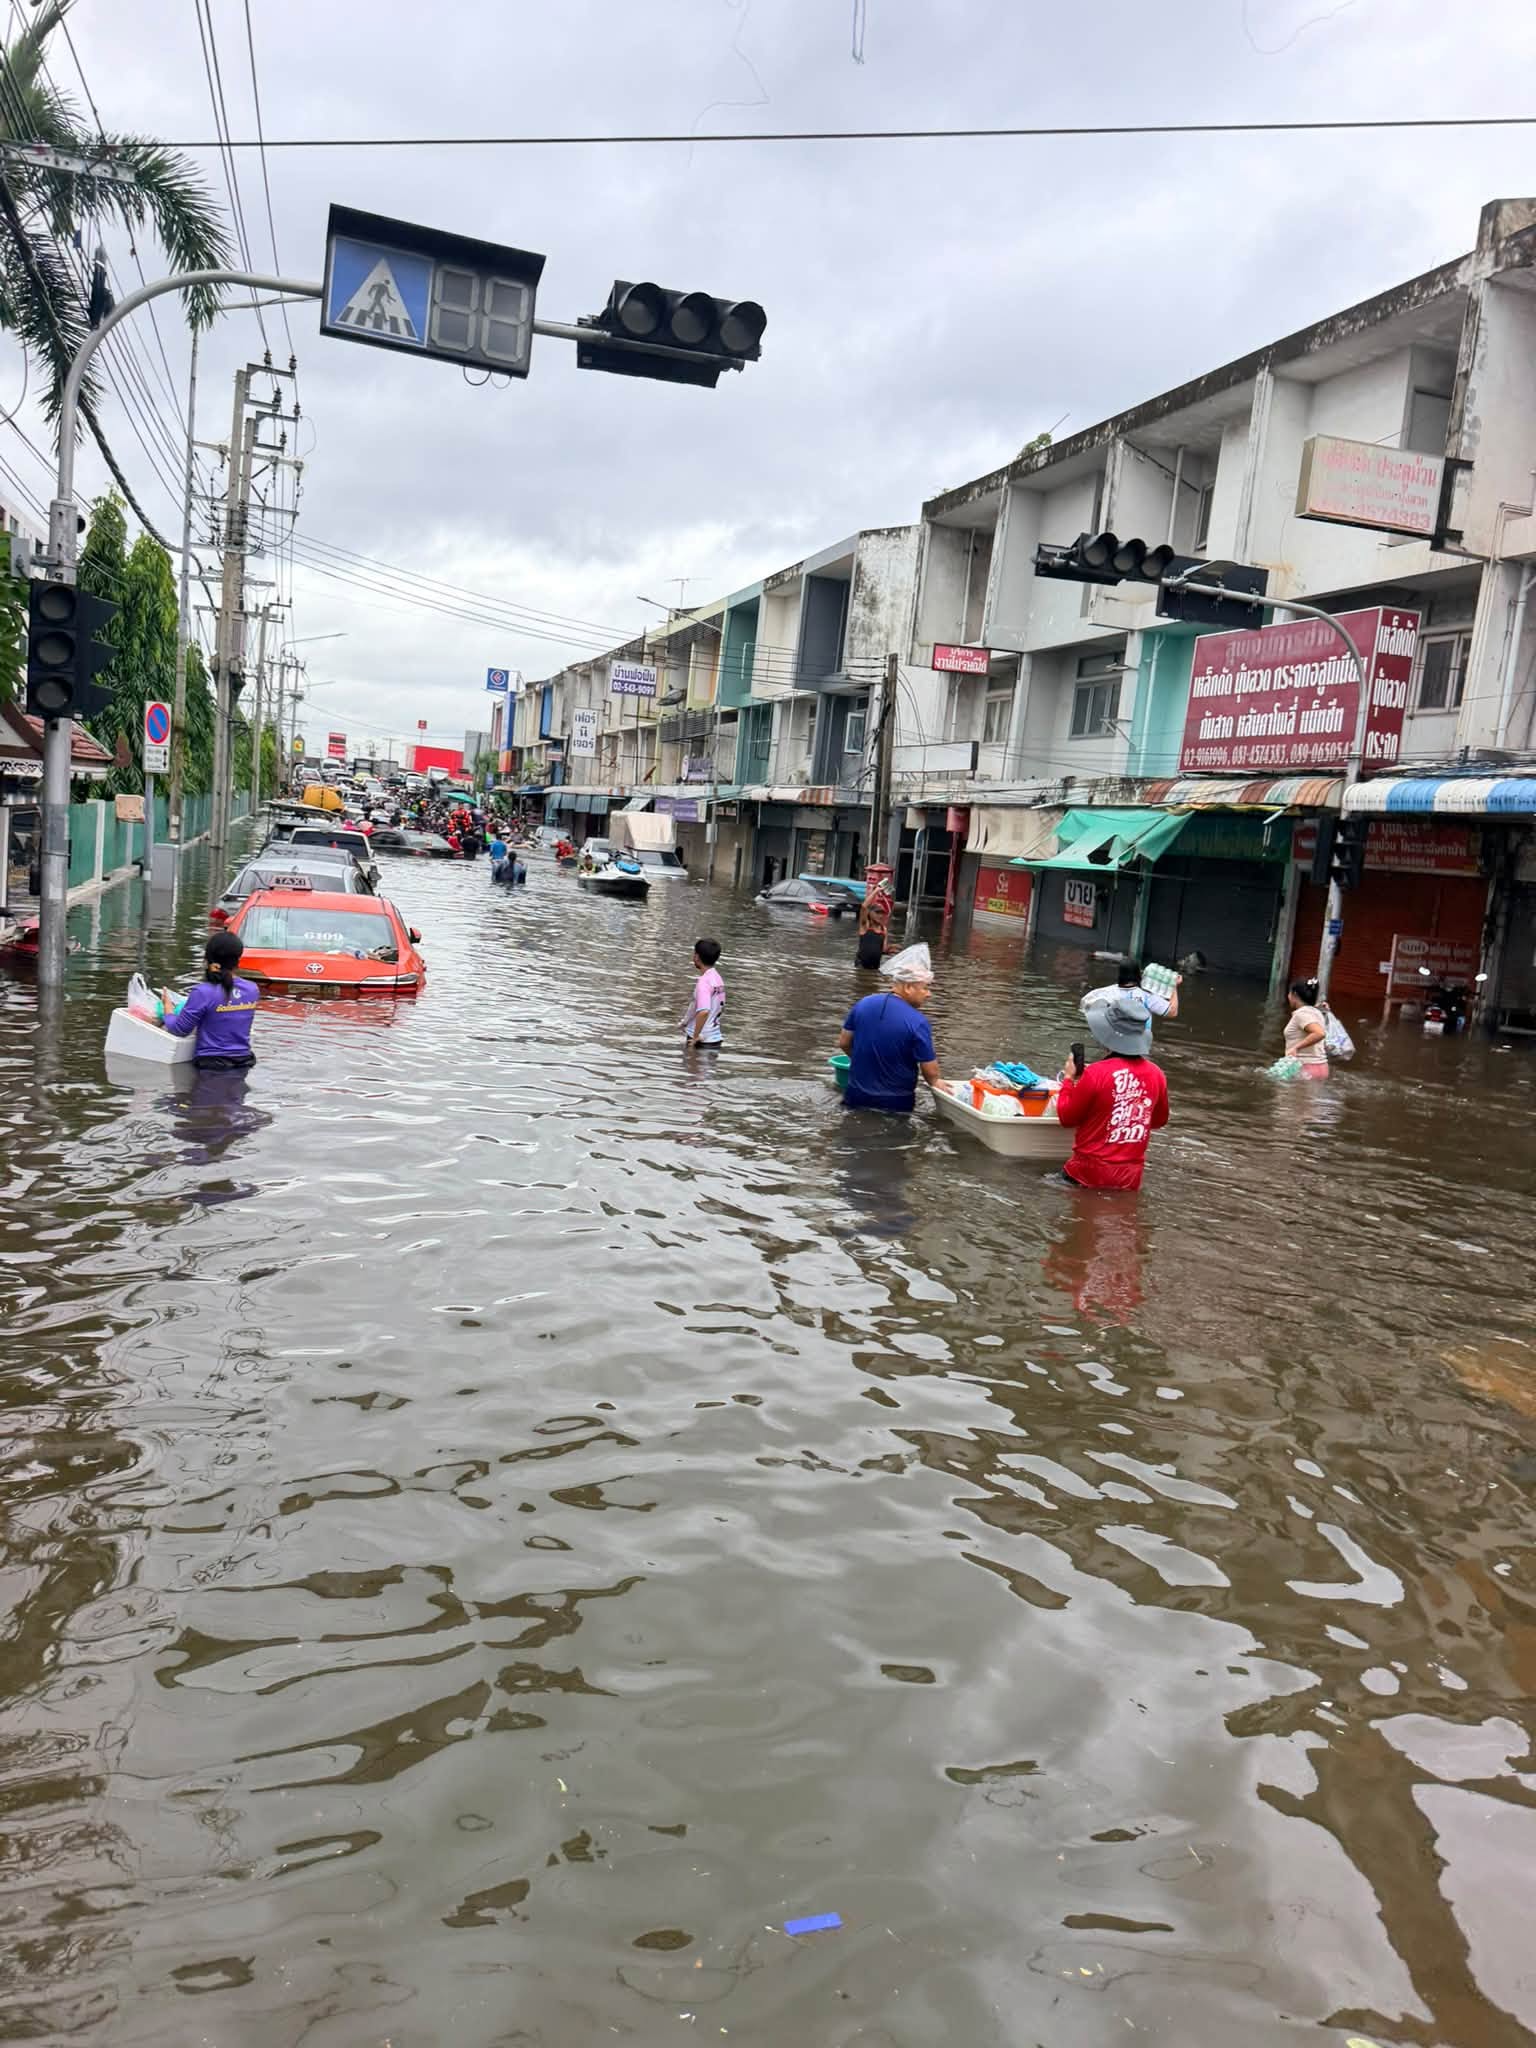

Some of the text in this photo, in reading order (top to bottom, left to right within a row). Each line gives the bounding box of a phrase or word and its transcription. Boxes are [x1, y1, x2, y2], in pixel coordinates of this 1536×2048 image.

[1377, 615, 1416, 657] เหล็กดัด
[1191, 665, 1233, 698] เหล็กดัด
[1234, 662, 1271, 703] มุ้งลวด
[1199, 711, 1233, 740] กันสาด
[1365, 730, 1399, 761] กระจก
[275, 877, 306, 887] TAXI
[1067, 881, 1094, 906] ขาย
